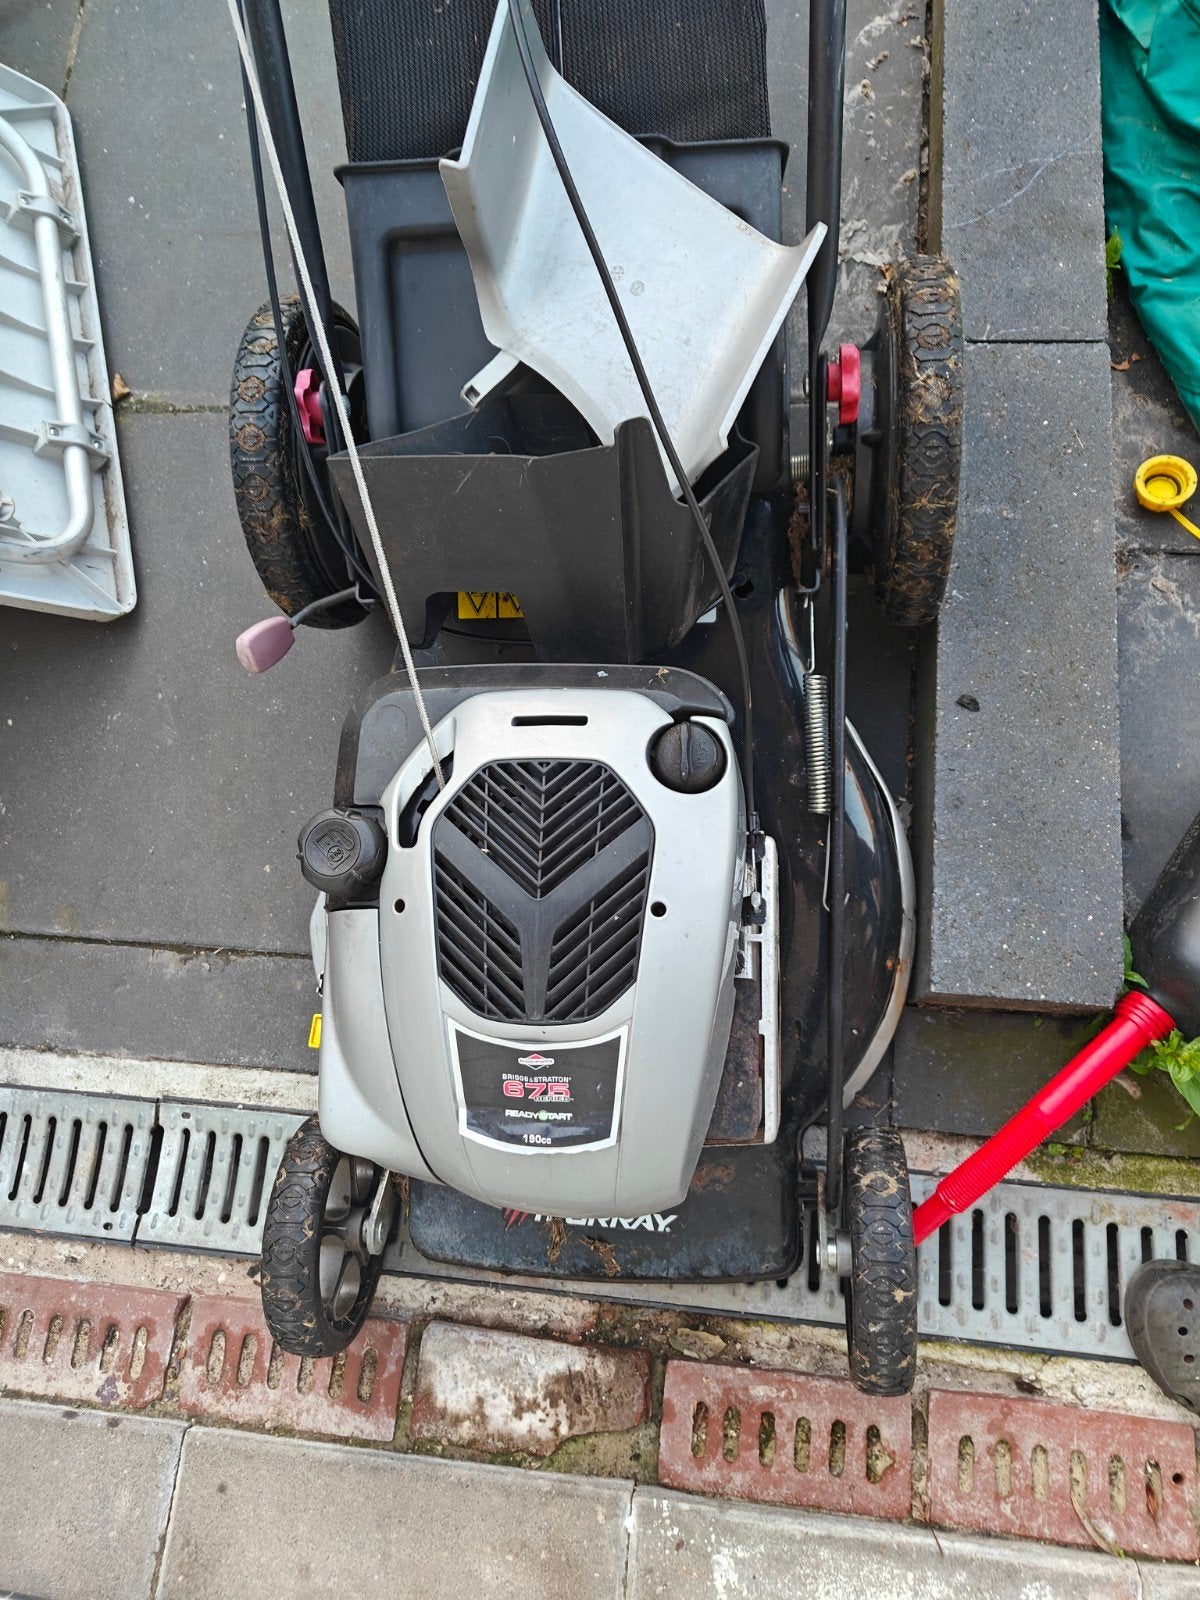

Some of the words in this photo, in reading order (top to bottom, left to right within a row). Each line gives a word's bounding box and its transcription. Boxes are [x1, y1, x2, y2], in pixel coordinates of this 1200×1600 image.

[502, 1073, 529, 1082] BRIGGS
[503, 1080, 570, 1099] 675
[523, 1133, 552, 1144] 190cc
